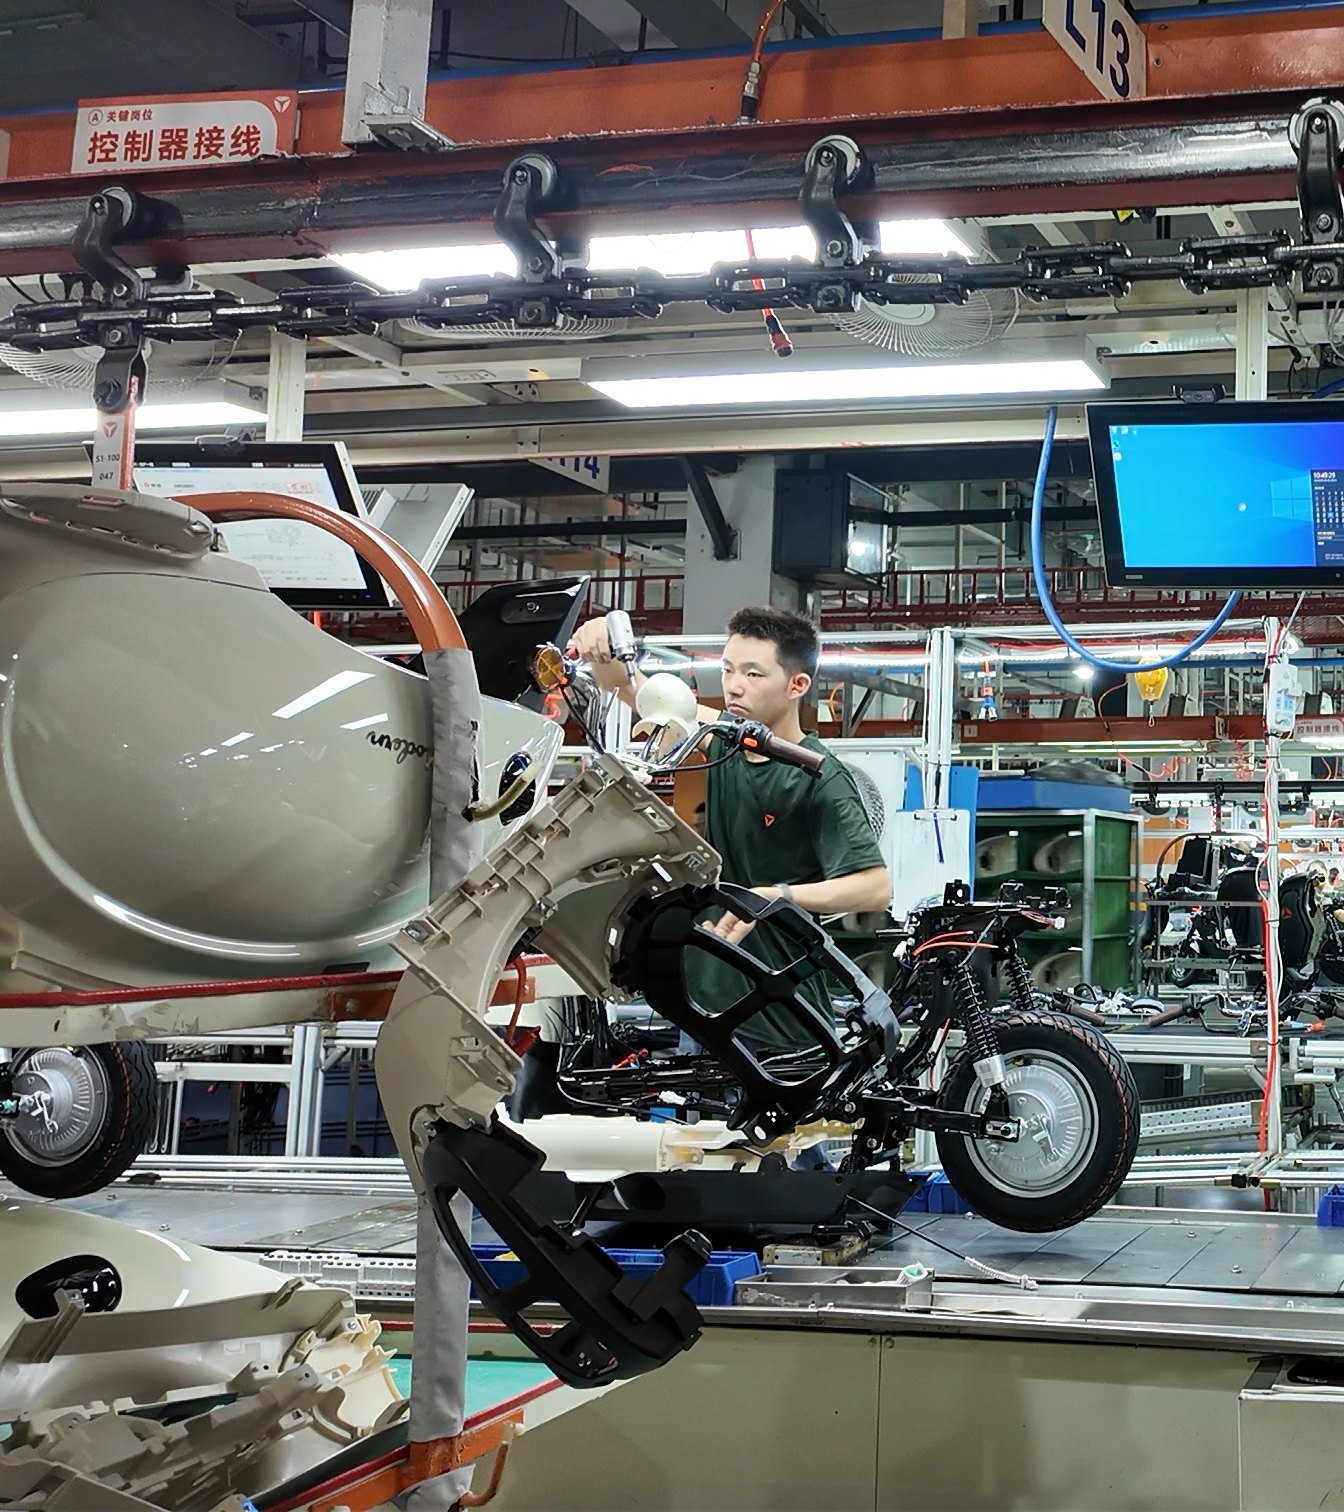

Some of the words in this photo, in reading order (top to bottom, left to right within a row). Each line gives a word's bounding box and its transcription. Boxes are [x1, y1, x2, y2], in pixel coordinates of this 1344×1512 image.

[1065, 0, 1130, 98] L13
[106, 109, 153, 123] 关键岗位
[87, 124, 261, 164] 控制器接线
[95, 453, 120, 463] S1-100
[99, 471, 114, 481] 047
